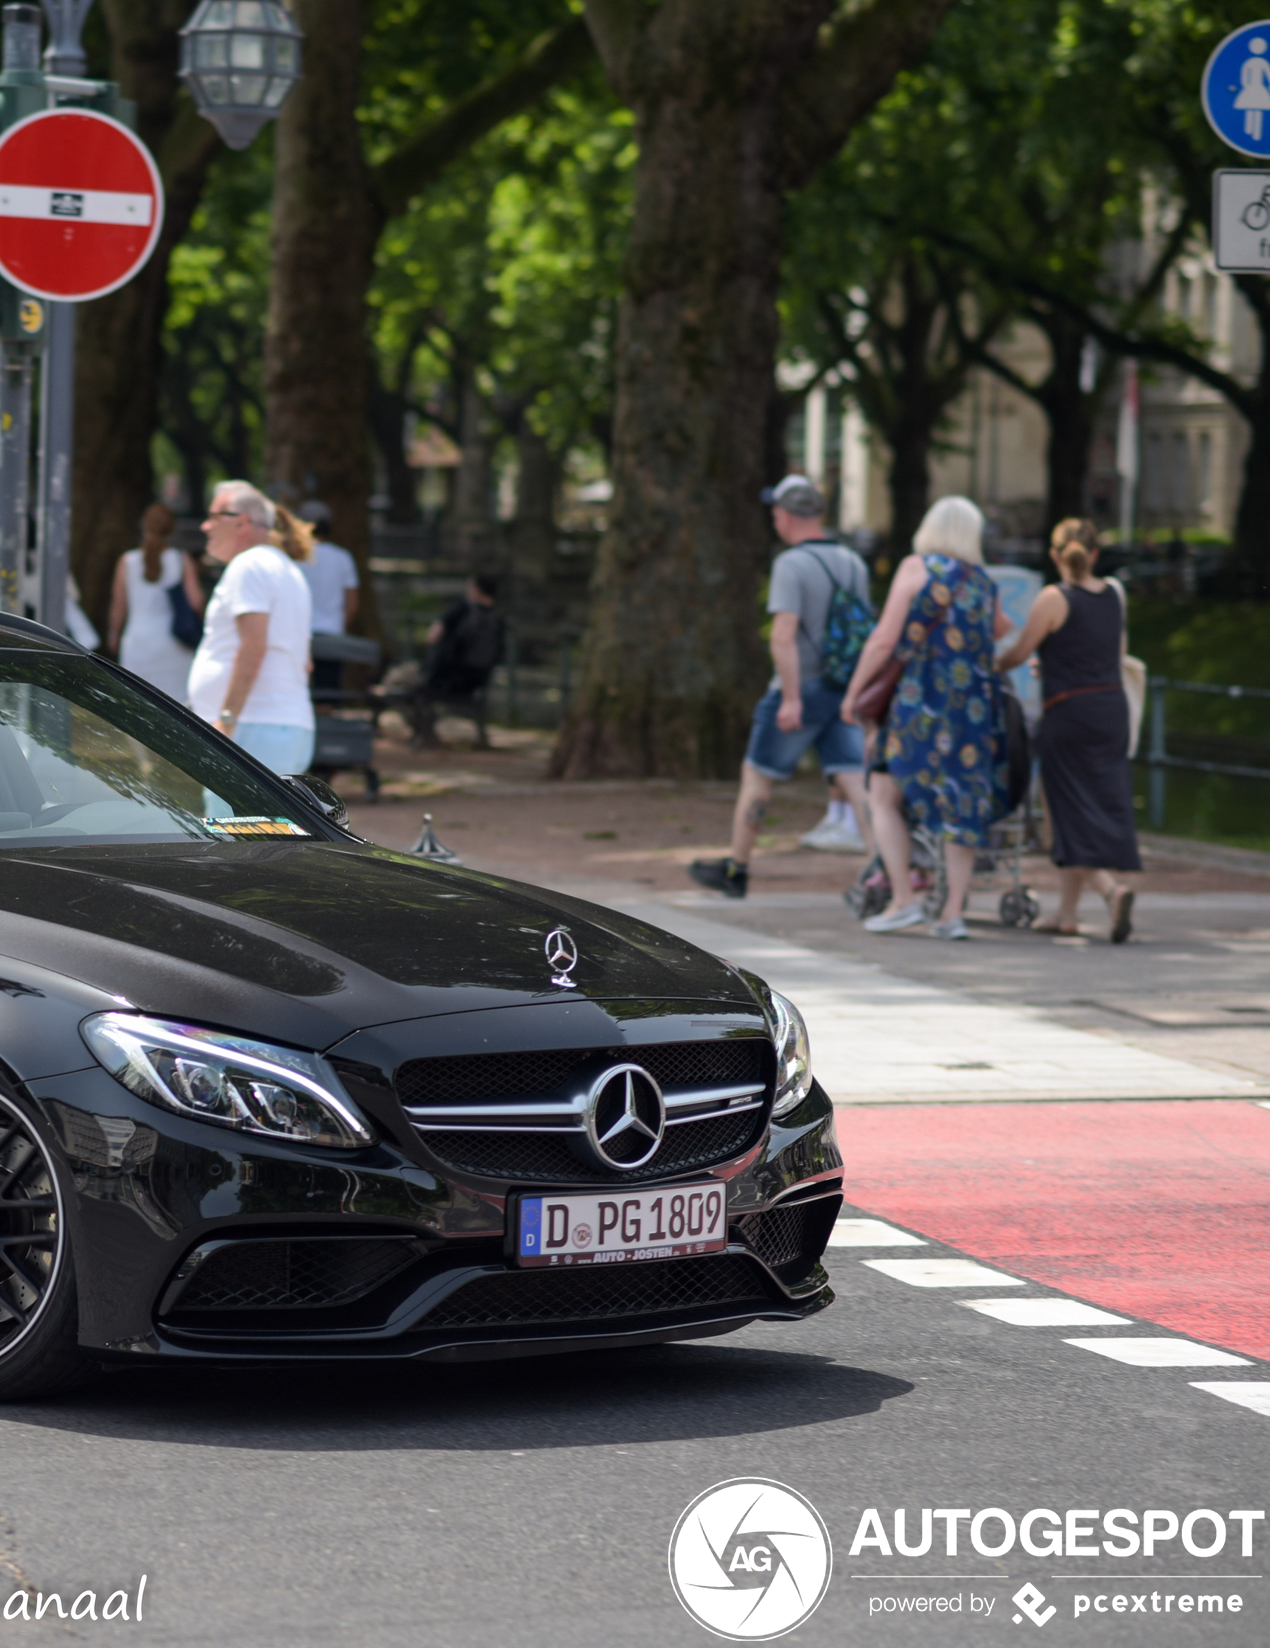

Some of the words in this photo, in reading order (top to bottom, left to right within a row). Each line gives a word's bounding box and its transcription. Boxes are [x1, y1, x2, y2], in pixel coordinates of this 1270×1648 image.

[546, 1204, 569, 1249] D
[598, 1199, 641, 1246] PG
[649, 1190, 721, 1242] 1809
[525, 1233, 535, 1247] D
